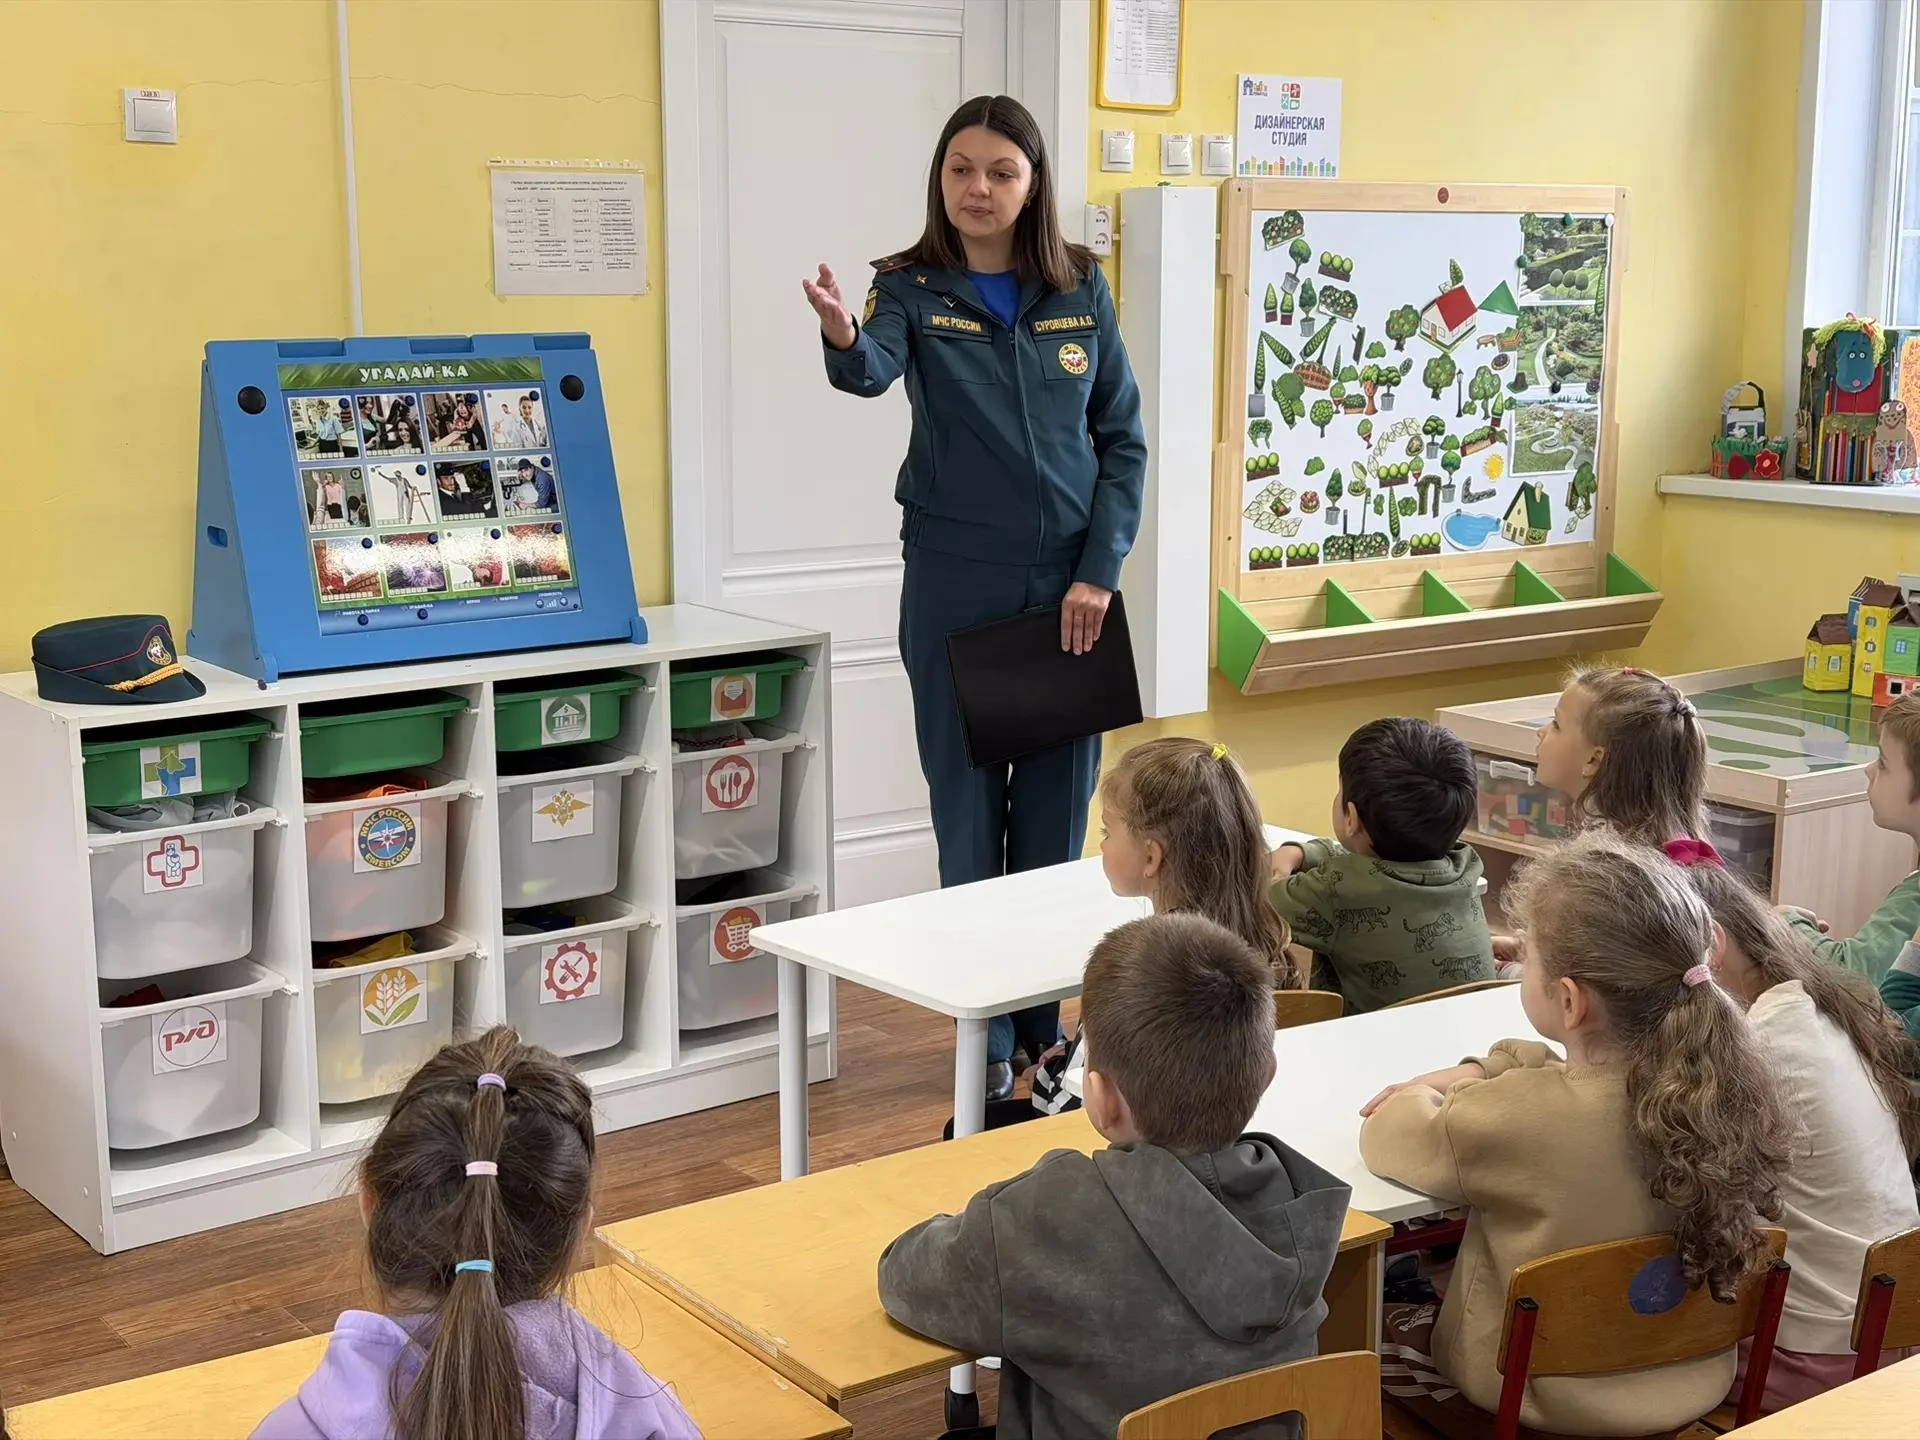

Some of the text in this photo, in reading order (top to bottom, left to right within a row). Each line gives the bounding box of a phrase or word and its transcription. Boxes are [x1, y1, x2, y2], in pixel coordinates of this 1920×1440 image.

[1254, 113, 1325, 130] ДИЗАЙНЕРСКАЯ
[1271, 131, 1307, 146] СТУДИЯ
[932, 315, 982, 332] МЧС РОССИИ
[1035, 315, 1096, 332] СУРОВЦЕВА А.О.
[359, 363, 469, 383] УГАДАЙ-КА
[360, 809, 414, 837] МЧС РОССИИ
[365, 847, 410, 868] EMERCOM
